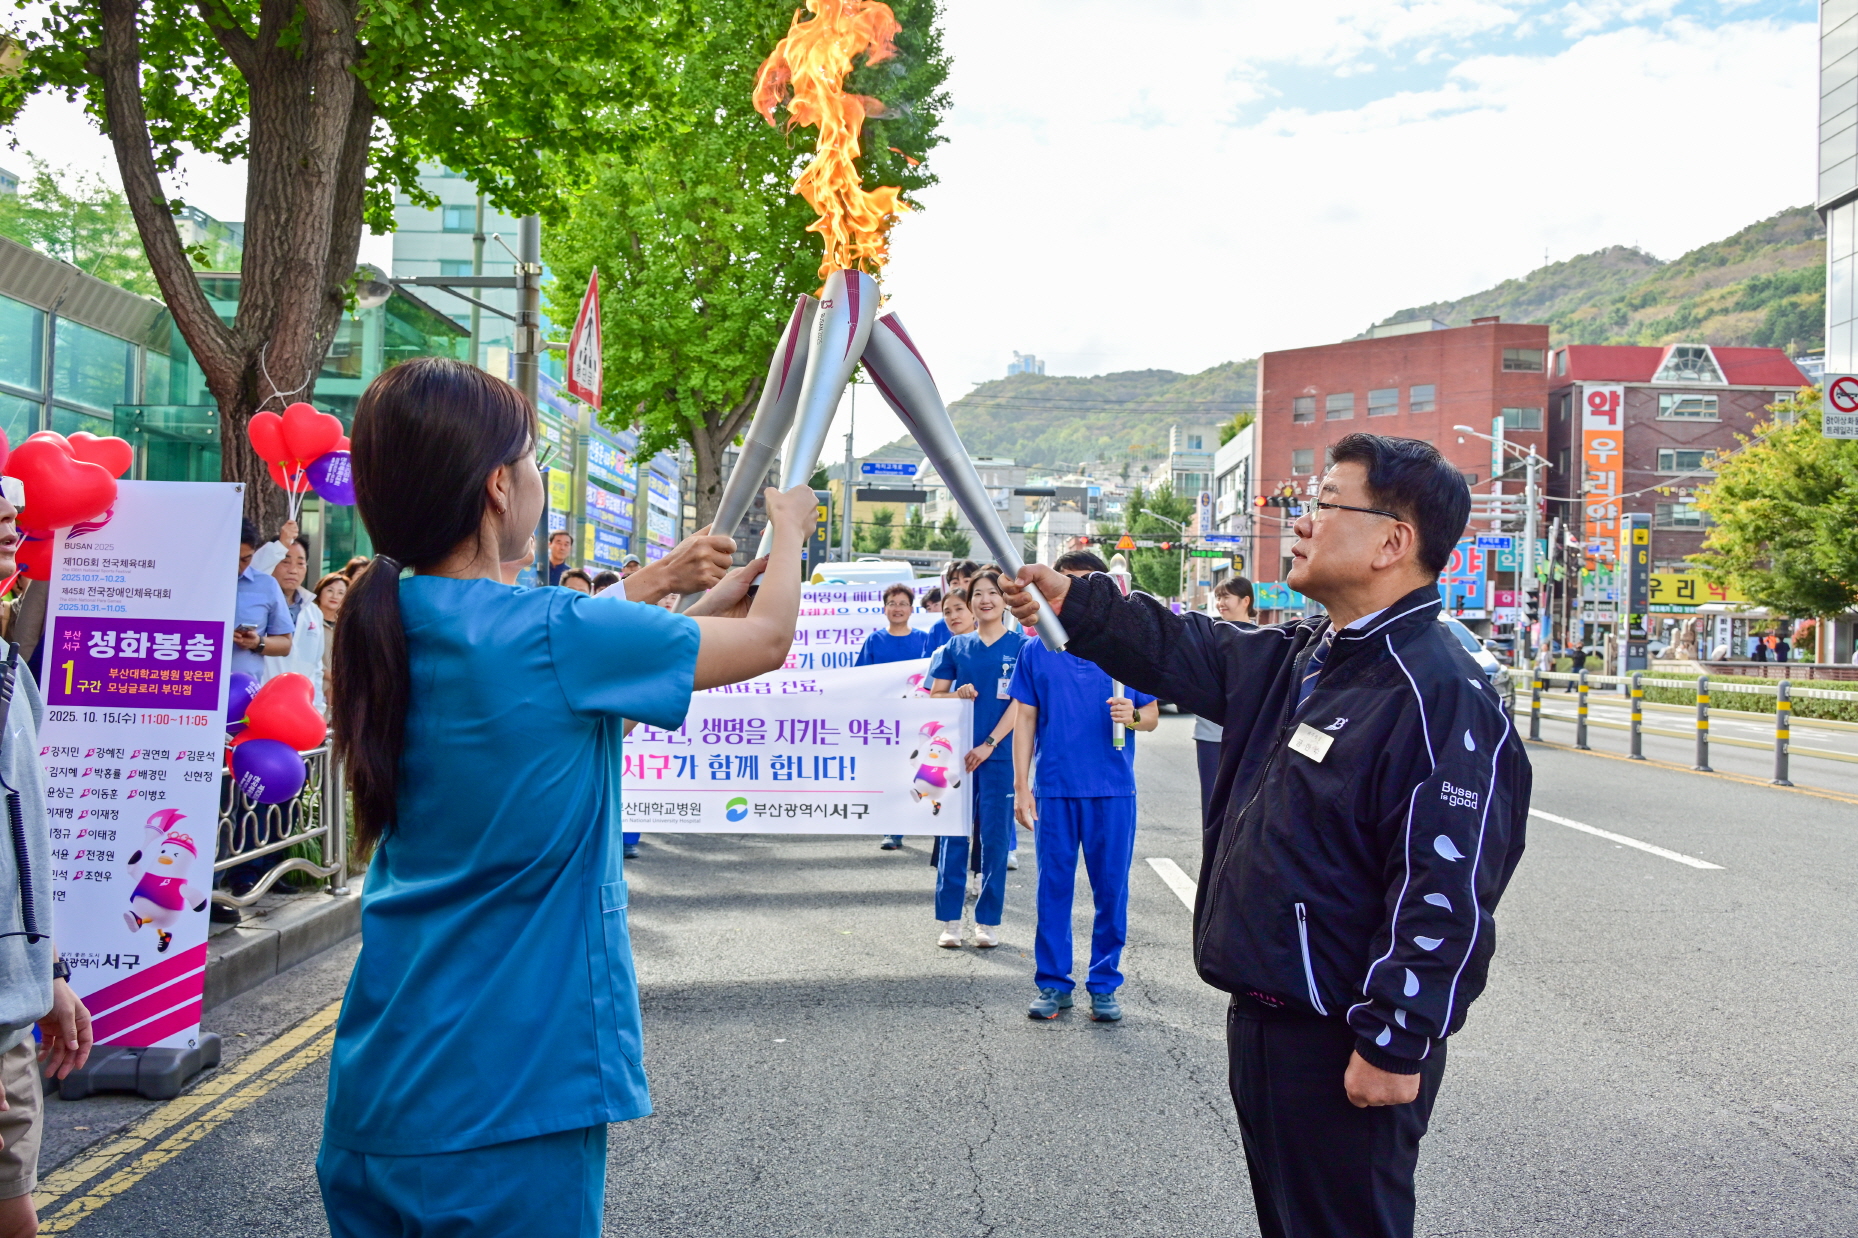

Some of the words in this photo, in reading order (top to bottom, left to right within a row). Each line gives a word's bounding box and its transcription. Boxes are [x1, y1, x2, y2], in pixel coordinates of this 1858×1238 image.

[1588, 391, 1621, 425] 약
[1586, 438, 1619, 564] 우리약국
[818, 528, 826, 542] 5
[63, 557, 99, 567] 제106회
[102, 558, 156, 569] 전국체육대회
[1638, 550, 1647, 564] 6
[62, 588, 86, 596] 제45회
[88, 586, 172, 599] 전국장애인체육대회
[803, 591, 848, 604] 희망의
[853, 587, 885, 603] 메디
[63, 630, 82, 640] 부산
[815, 628, 866, 646] 뜨거운
[62, 642, 81, 652] 서구
[88, 630, 215, 662] 성화봉송
[62, 660, 74, 695] 1
[108, 668, 180, 681] 부산대학교병원
[183, 670, 214, 682] 맞은편
[77, 680, 102, 693] 구간
[106, 682, 158, 694] 모닝글로리
[162, 684, 192, 696] 부민점
[708, 682, 772, 694] 대표급
[780, 679, 824, 696] 진료,
[49, 710, 78, 722] 2025.
[83, 711, 98, 723] 10.
[140, 713, 208, 726] 11:00~11:05
[700, 718, 768, 745] 생명을
[774, 718, 841, 746] 지키는
[848, 718, 902, 746] 약속!
[50, 746, 80, 758] 강지민
[96, 748, 125, 760] 강혜진
[142, 749, 170, 760] 권연희
[187, 750, 216, 762] 김문석
[50, 766, 78, 778] 김지혜
[94, 768, 122, 780] 박홍률
[138, 769, 167, 782] 배경민
[184, 770, 213, 782] 신현정
[622, 754, 699, 781] 서구가
[708, 754, 759, 781] 함께
[769, 754, 856, 782] 합니다!
[46, 787, 74, 798] 윤상근
[91, 788, 118, 800] 이동훈
[138, 790, 166, 801] 이병호
[1442, 780, 1478, 801] Busan
[1440, 792, 1448, 801] is
[1449, 794, 1478, 810] good
[47, 808, 74, 820] 이재명
[90, 809, 119, 821] 이재정
[88, 830, 116, 842] 이태경
[86, 850, 115, 862] 전경원
[84, 870, 112, 882] 조현우
[102, 954, 140, 970] 서구
